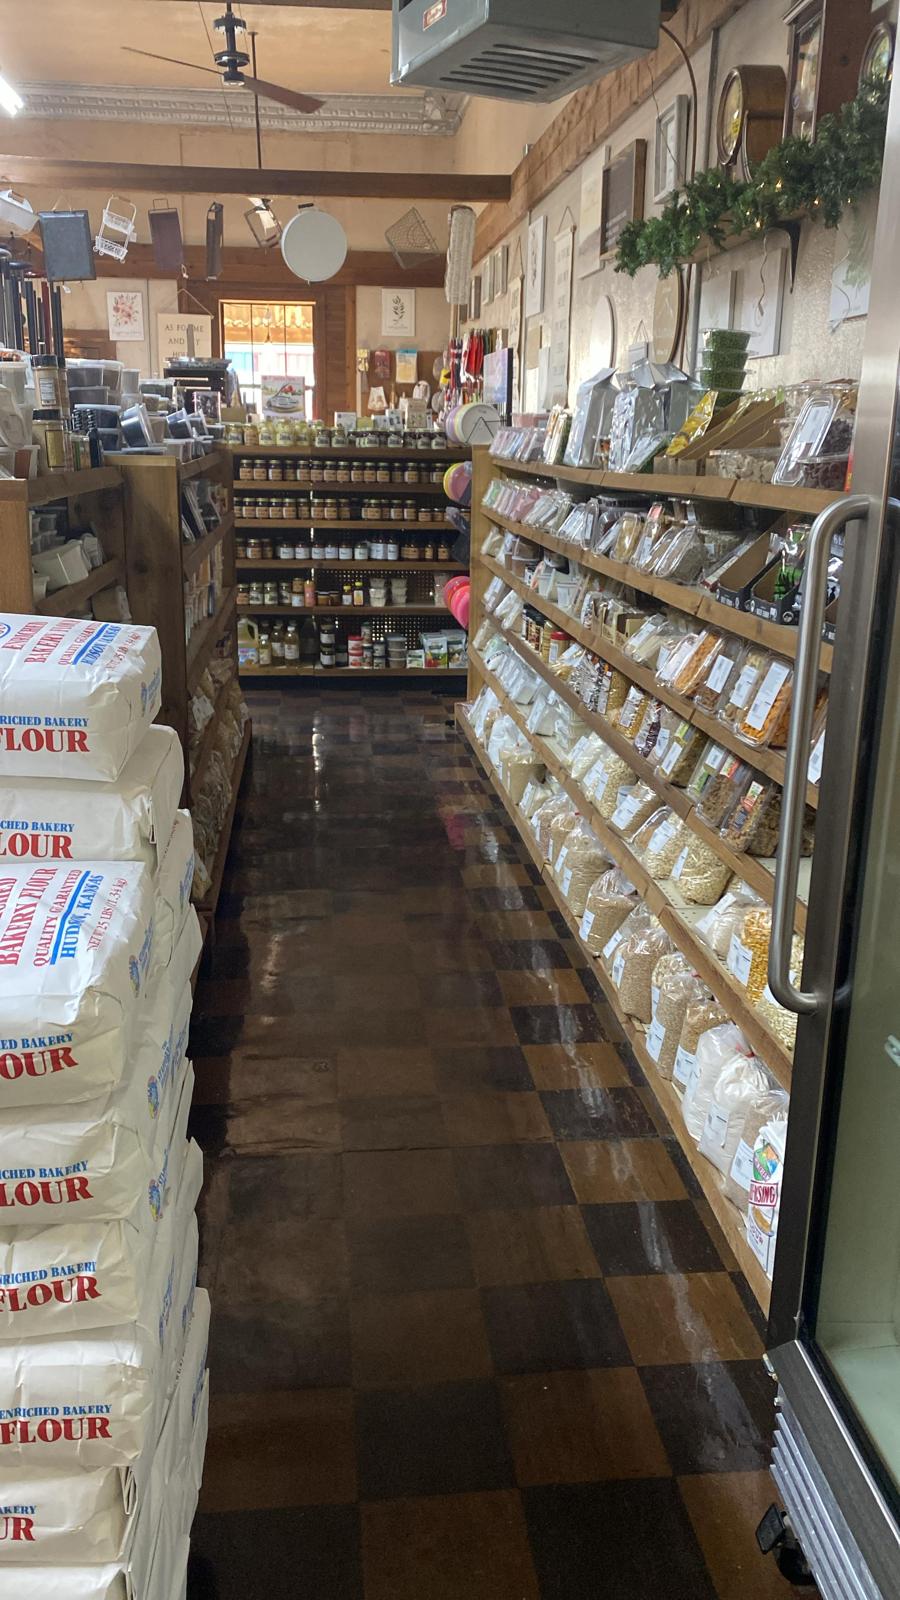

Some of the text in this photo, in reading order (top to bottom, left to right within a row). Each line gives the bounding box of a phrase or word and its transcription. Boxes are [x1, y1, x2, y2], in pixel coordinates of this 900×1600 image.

[165, 323, 174, 331] AS
[168, 337, 185, 345] AND
[45, 717, 89, 727] BAKERY
[0, 727, 90, 752] LOUR
[0, 820, 74, 832] CHED BAKERY
[77, 875, 104, 910] KANSAS
[0, 902, 38, 966] BAKERY
[19, 868, 58, 899] FLOUR
[33, 912, 58, 967] QUALITY
[21, 1033, 73, 1049] BAKERY
[39, 1160, 88, 1178] BAKERY
[0, 1269, 48, 1285] RICHED
[0, 1404, 112, 1420] ENRICHED BAKERY
[0, 1416, 112, 1445] FLOUR
